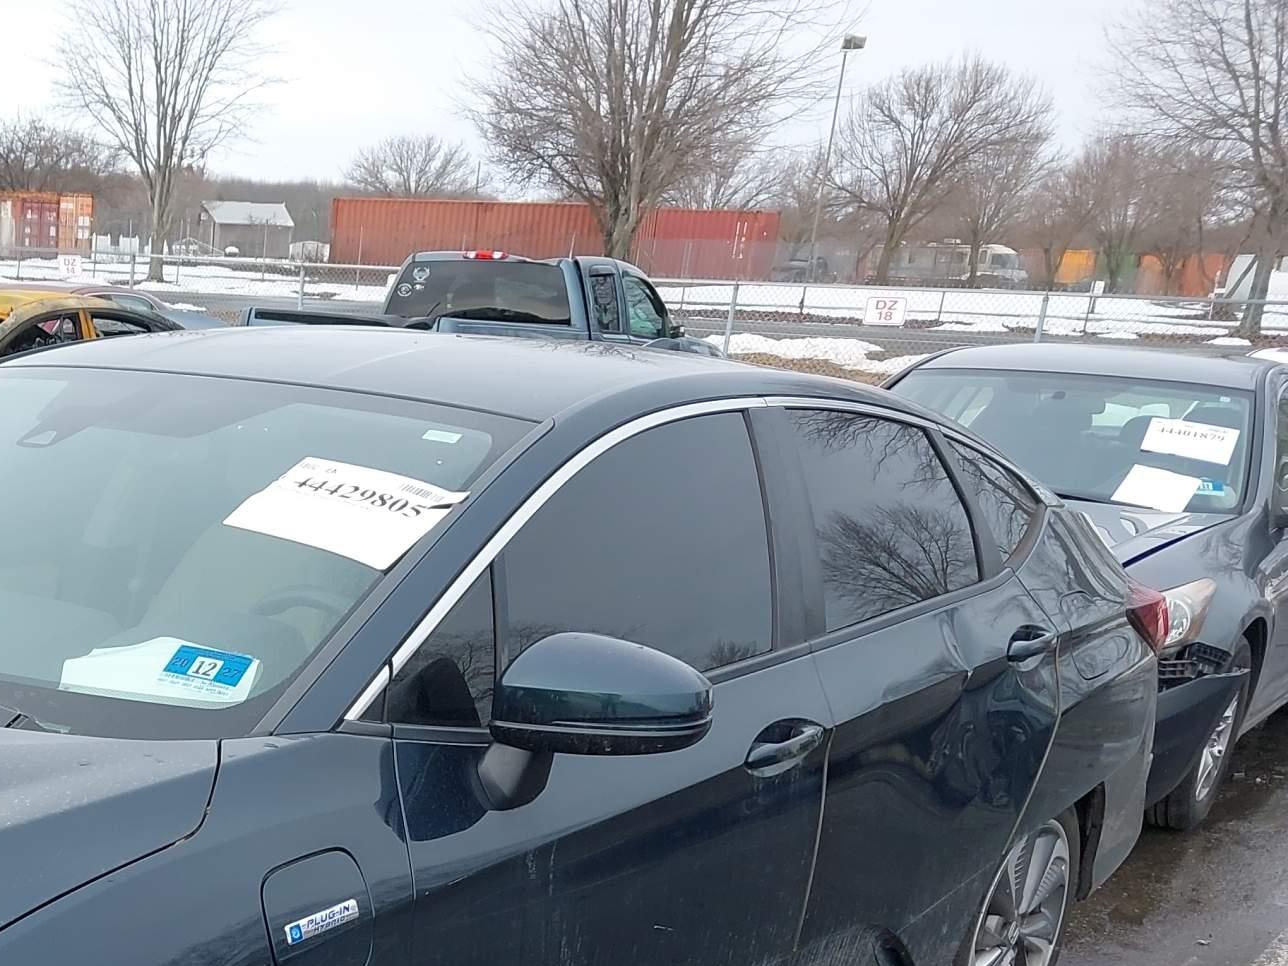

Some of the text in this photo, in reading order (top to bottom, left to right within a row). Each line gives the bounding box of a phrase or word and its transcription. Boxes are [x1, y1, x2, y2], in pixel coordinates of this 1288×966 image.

[63, 258, 77, 266] DZ
[875, 300, 898, 310] DZ
[878, 311, 892, 321] 18
[293, 476, 427, 518] 44429805
[171, 656, 189, 668] 20
[192, 660, 218, 677] 12
[223, 667, 242, 678] 27
[307, 904, 350, 929] PLUG-IN
